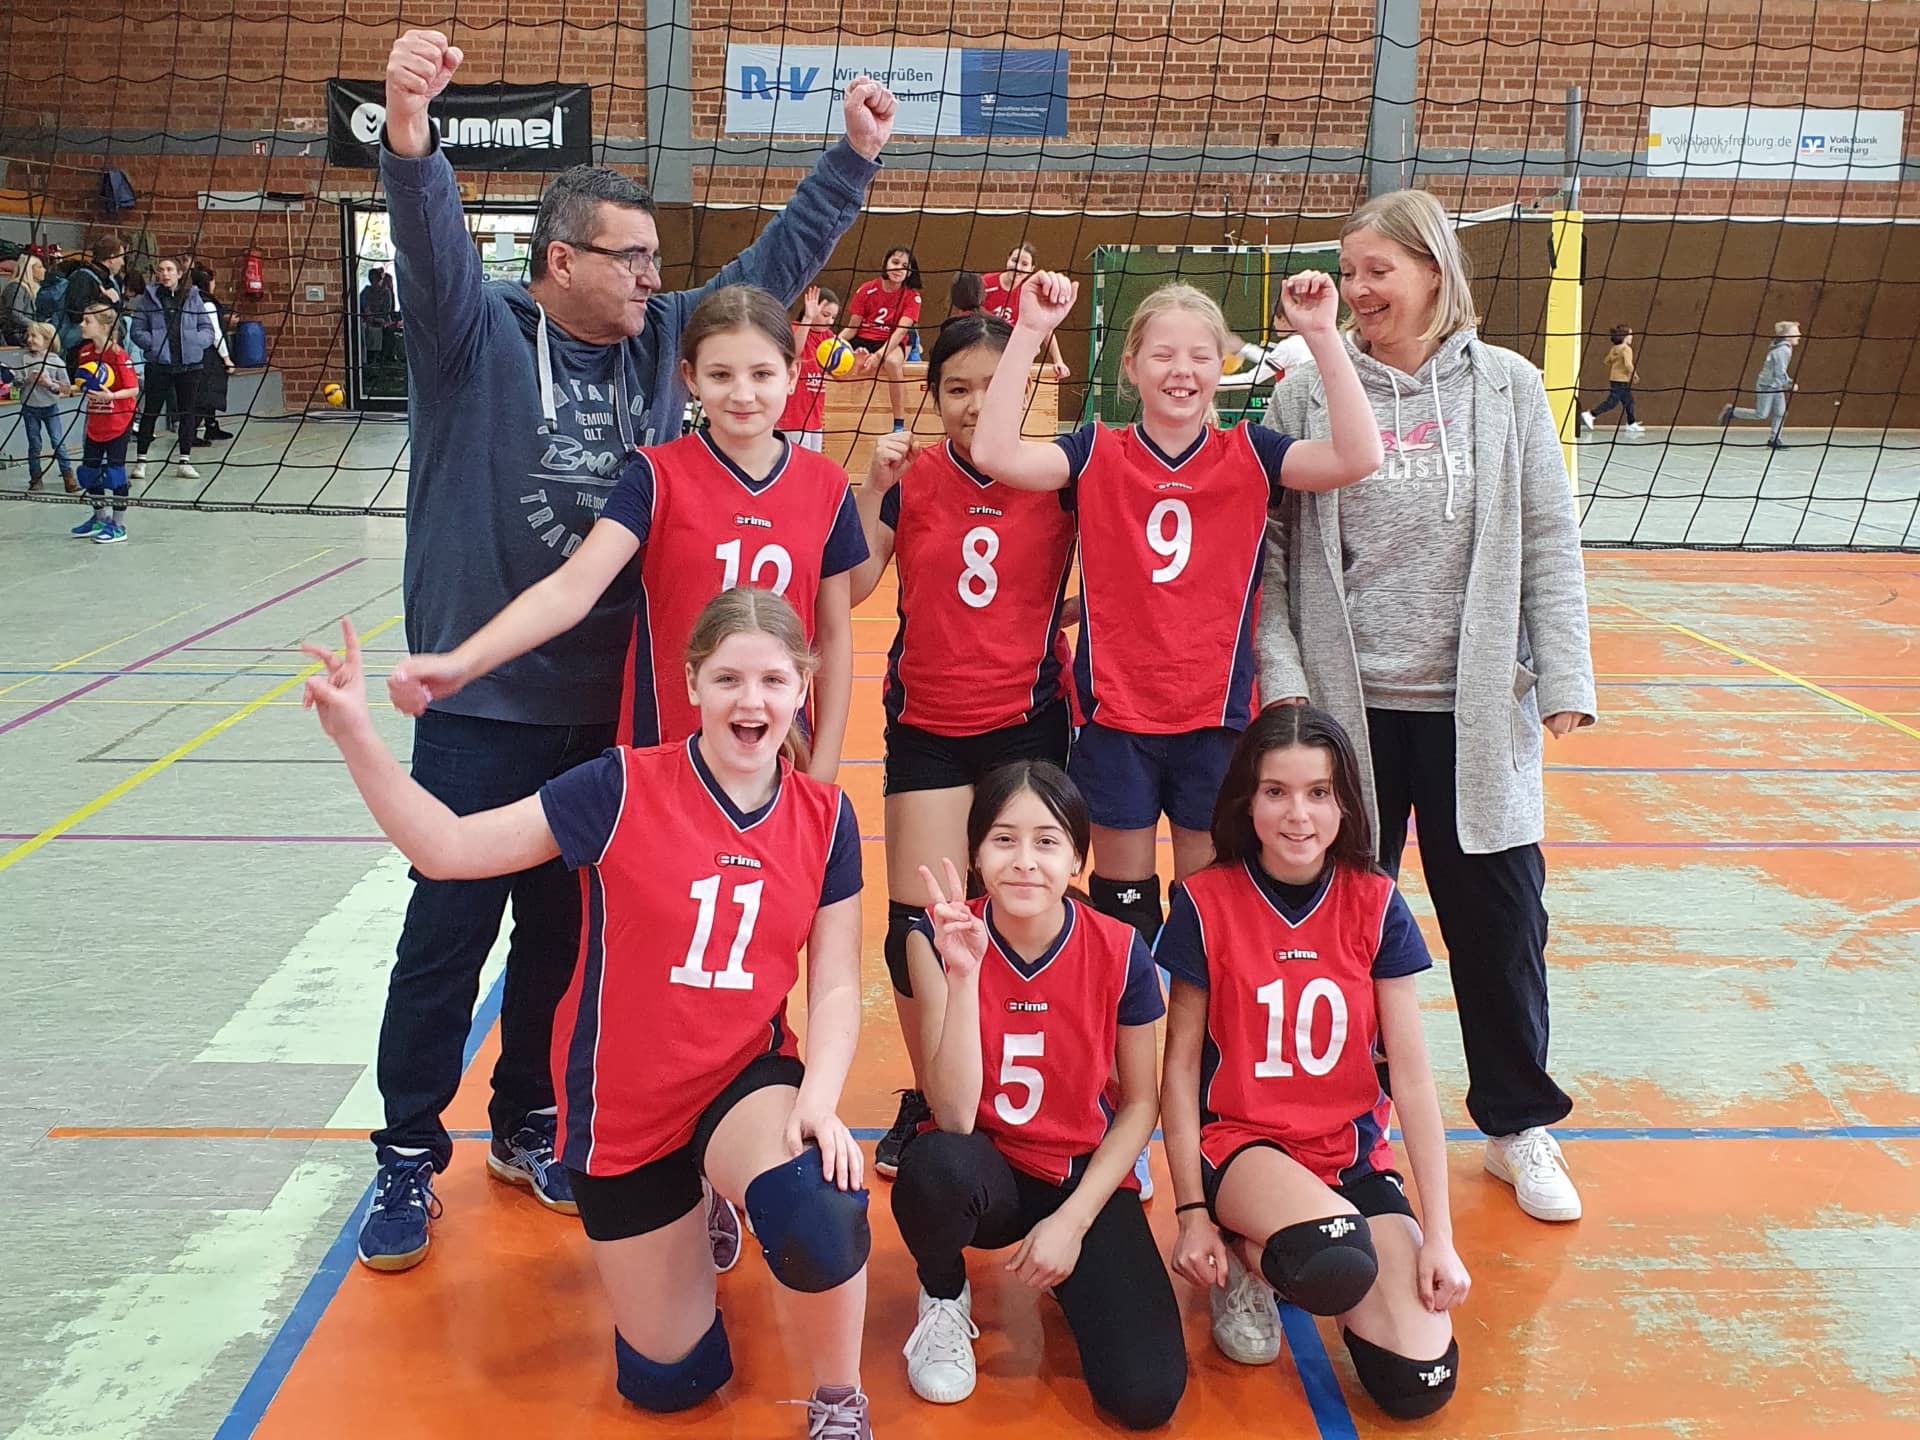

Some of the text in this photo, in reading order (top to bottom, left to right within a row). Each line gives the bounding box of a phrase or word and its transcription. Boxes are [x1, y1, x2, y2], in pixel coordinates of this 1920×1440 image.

[834, 67, 933, 85] Wir begrüßen
[431, 106, 564, 149] ummel
[874, 307, 888, 324] 2
[958, 526, 999, 608] 8
[1146, 498, 1193, 583] 9
[669, 873, 764, 990] 11
[1255, 977, 1348, 1078] 10
[994, 1031, 1044, 1126] 5
